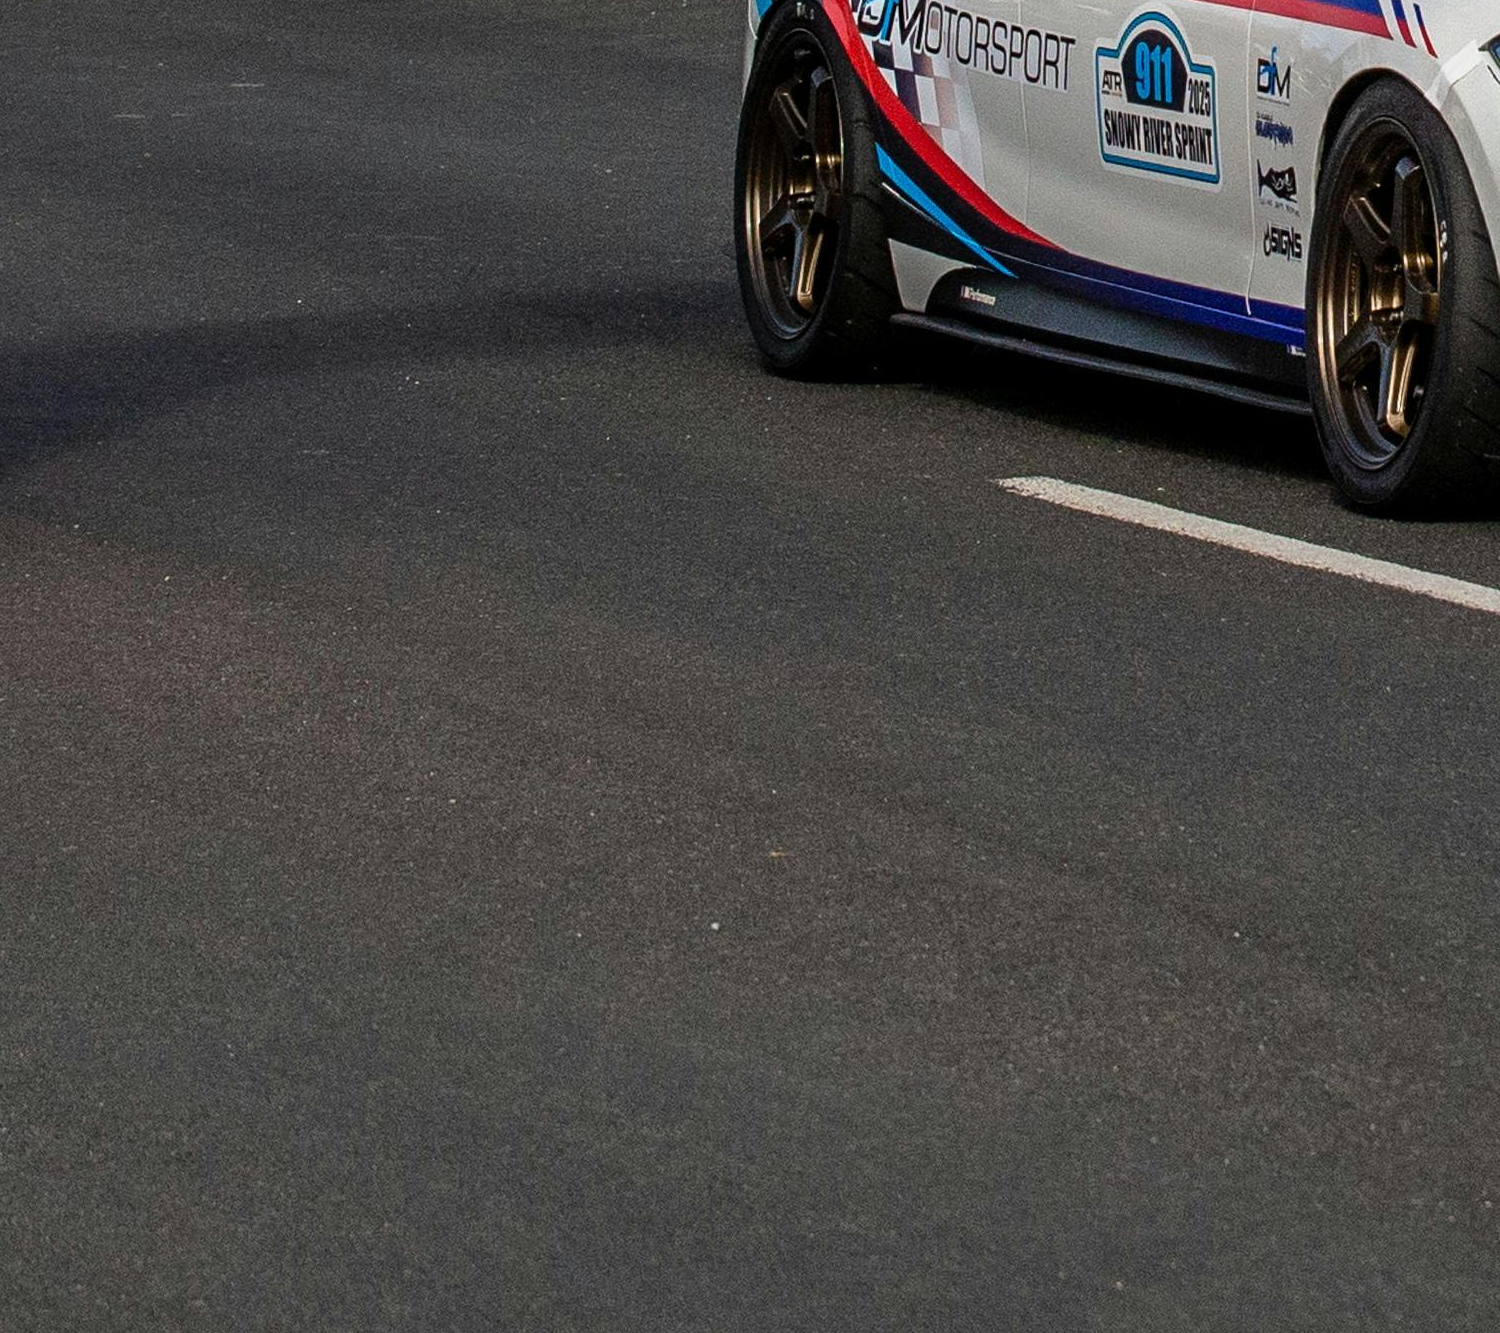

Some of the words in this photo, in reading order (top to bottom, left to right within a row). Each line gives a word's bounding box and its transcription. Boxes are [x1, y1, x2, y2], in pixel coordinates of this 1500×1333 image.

[1102, 70, 1123, 92] ATR
[1135, 41, 1174, 104] 911
[1188, 77, 1211, 118] 2025
[1104, 108, 1141, 152] SNOWY
[1142, 116, 1174, 159] RIVER
[1175, 122, 1213, 166] SPRINT
